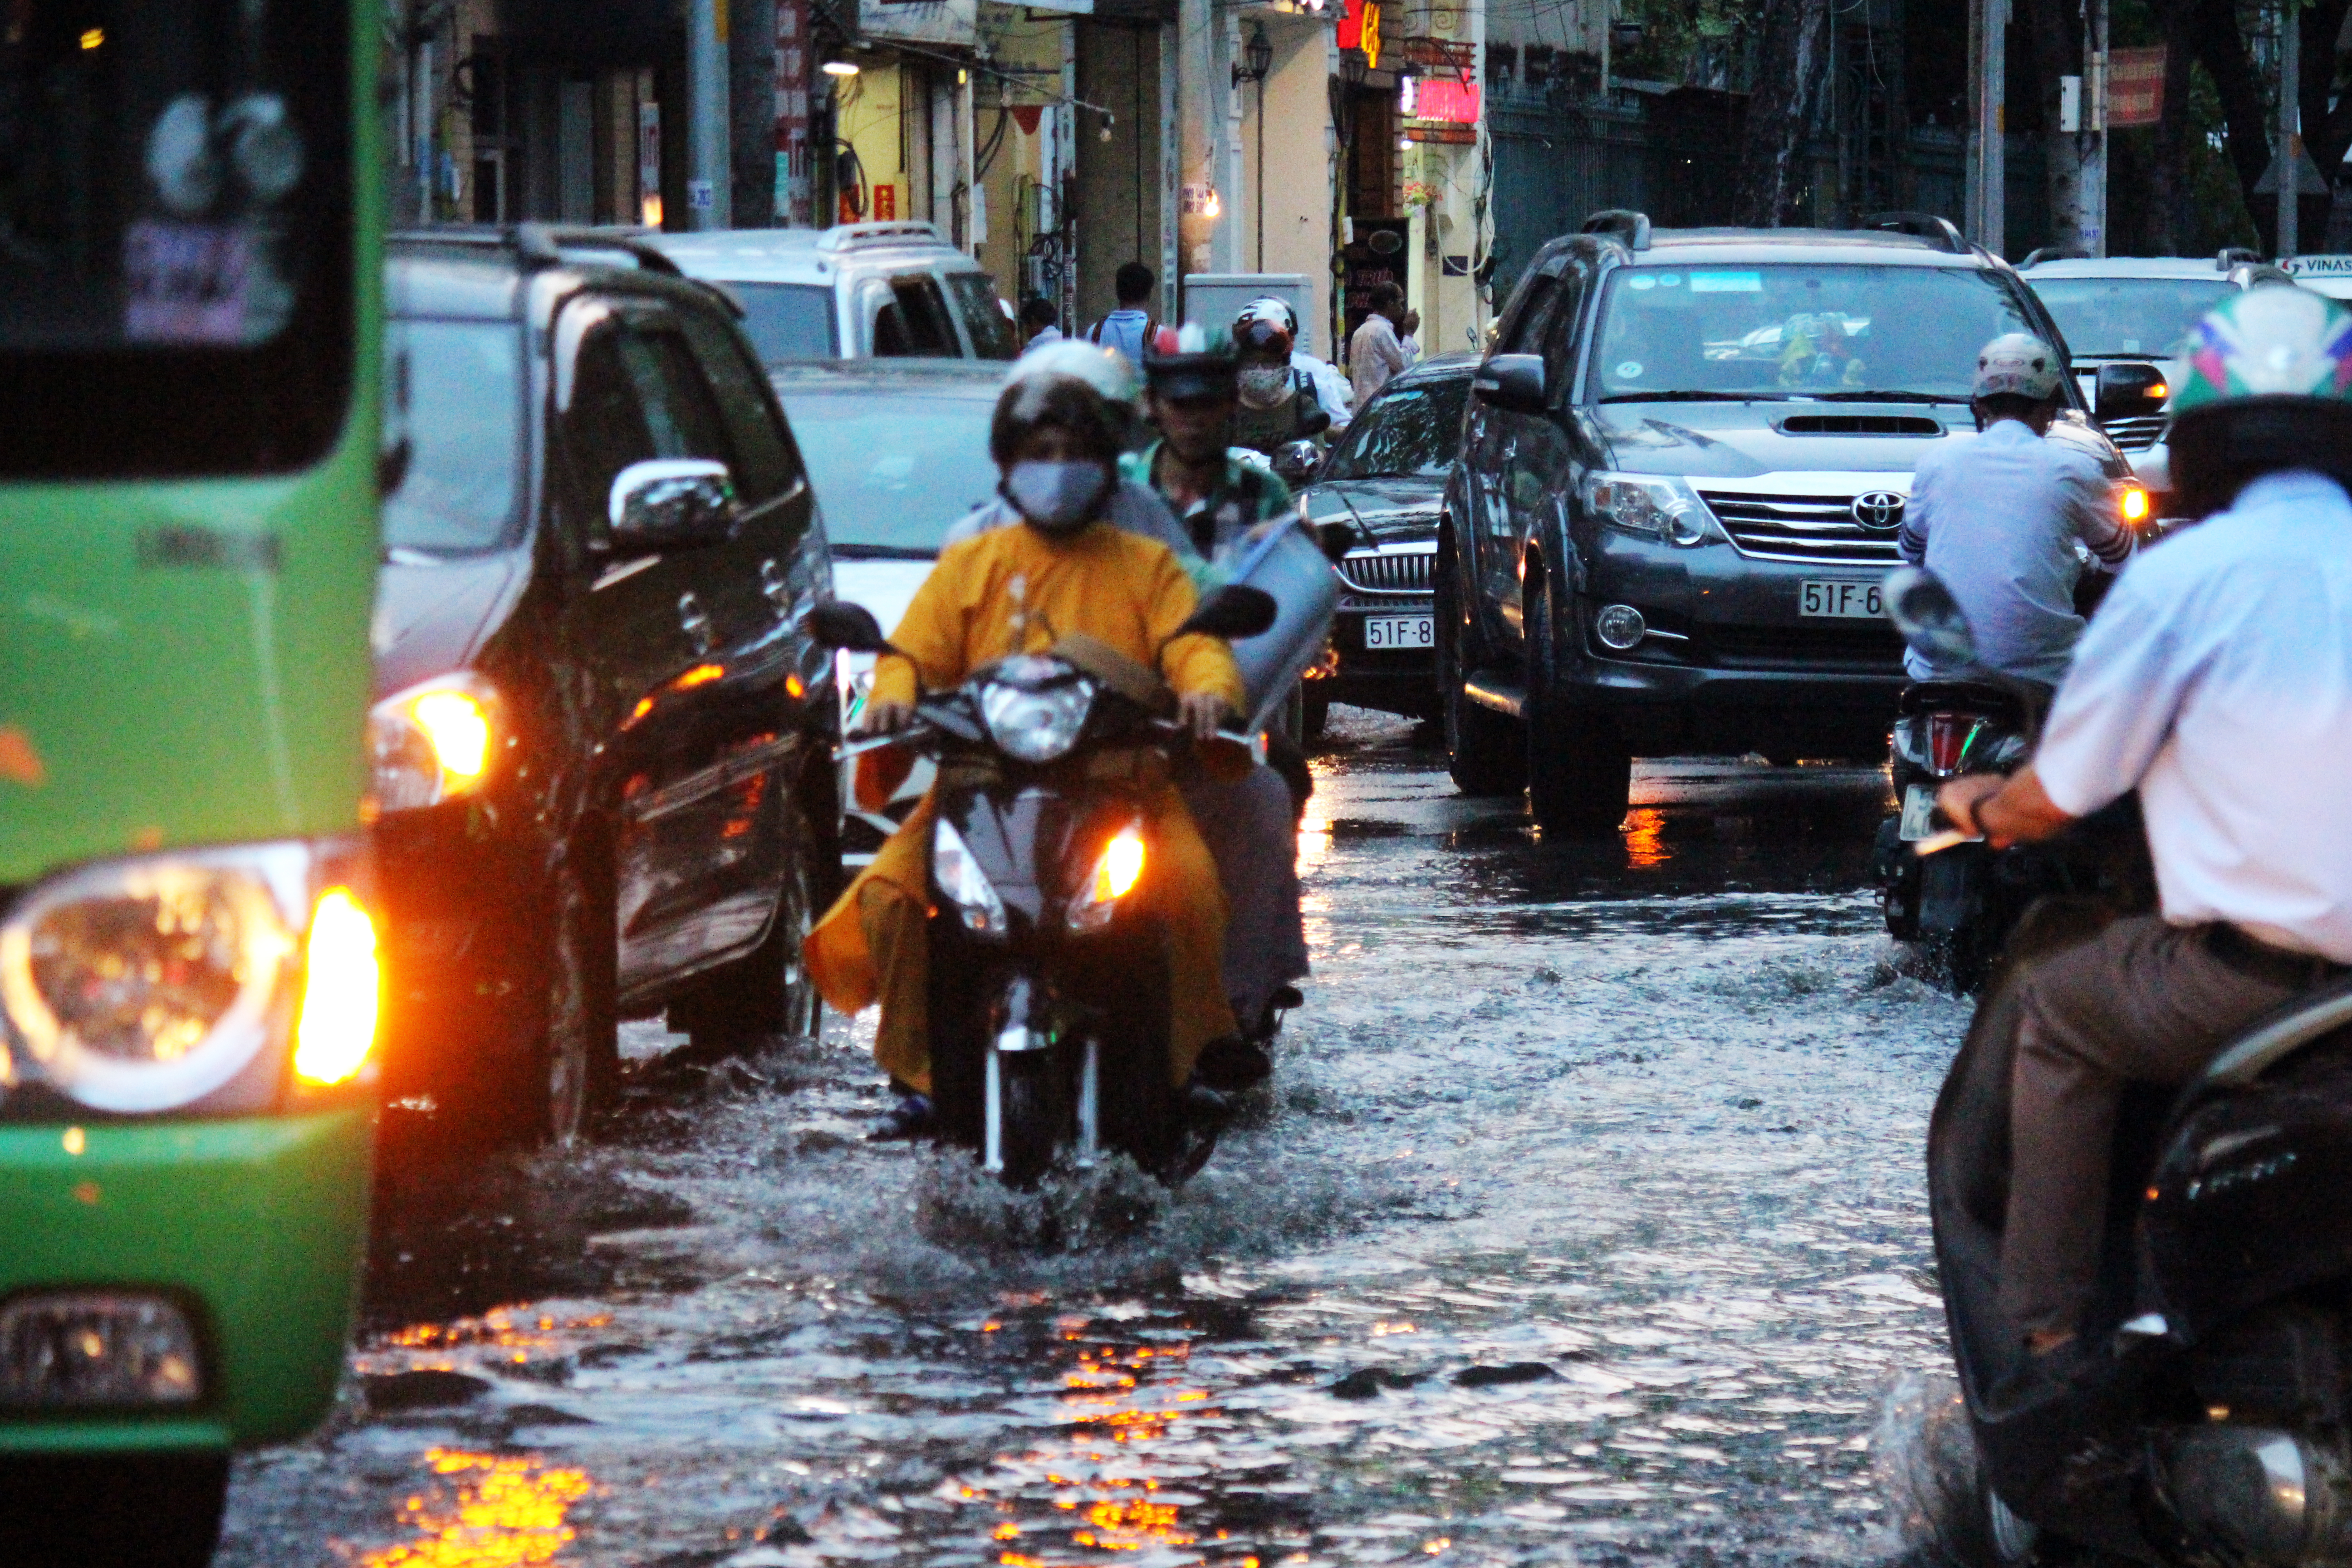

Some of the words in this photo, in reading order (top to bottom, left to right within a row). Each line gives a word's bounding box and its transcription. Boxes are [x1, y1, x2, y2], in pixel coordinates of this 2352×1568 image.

[2307, 260, 2352, 272] VINAS
[1805, 583, 1882, 614] 51F-6
[1369, 621, 1431, 645] 51F-8
